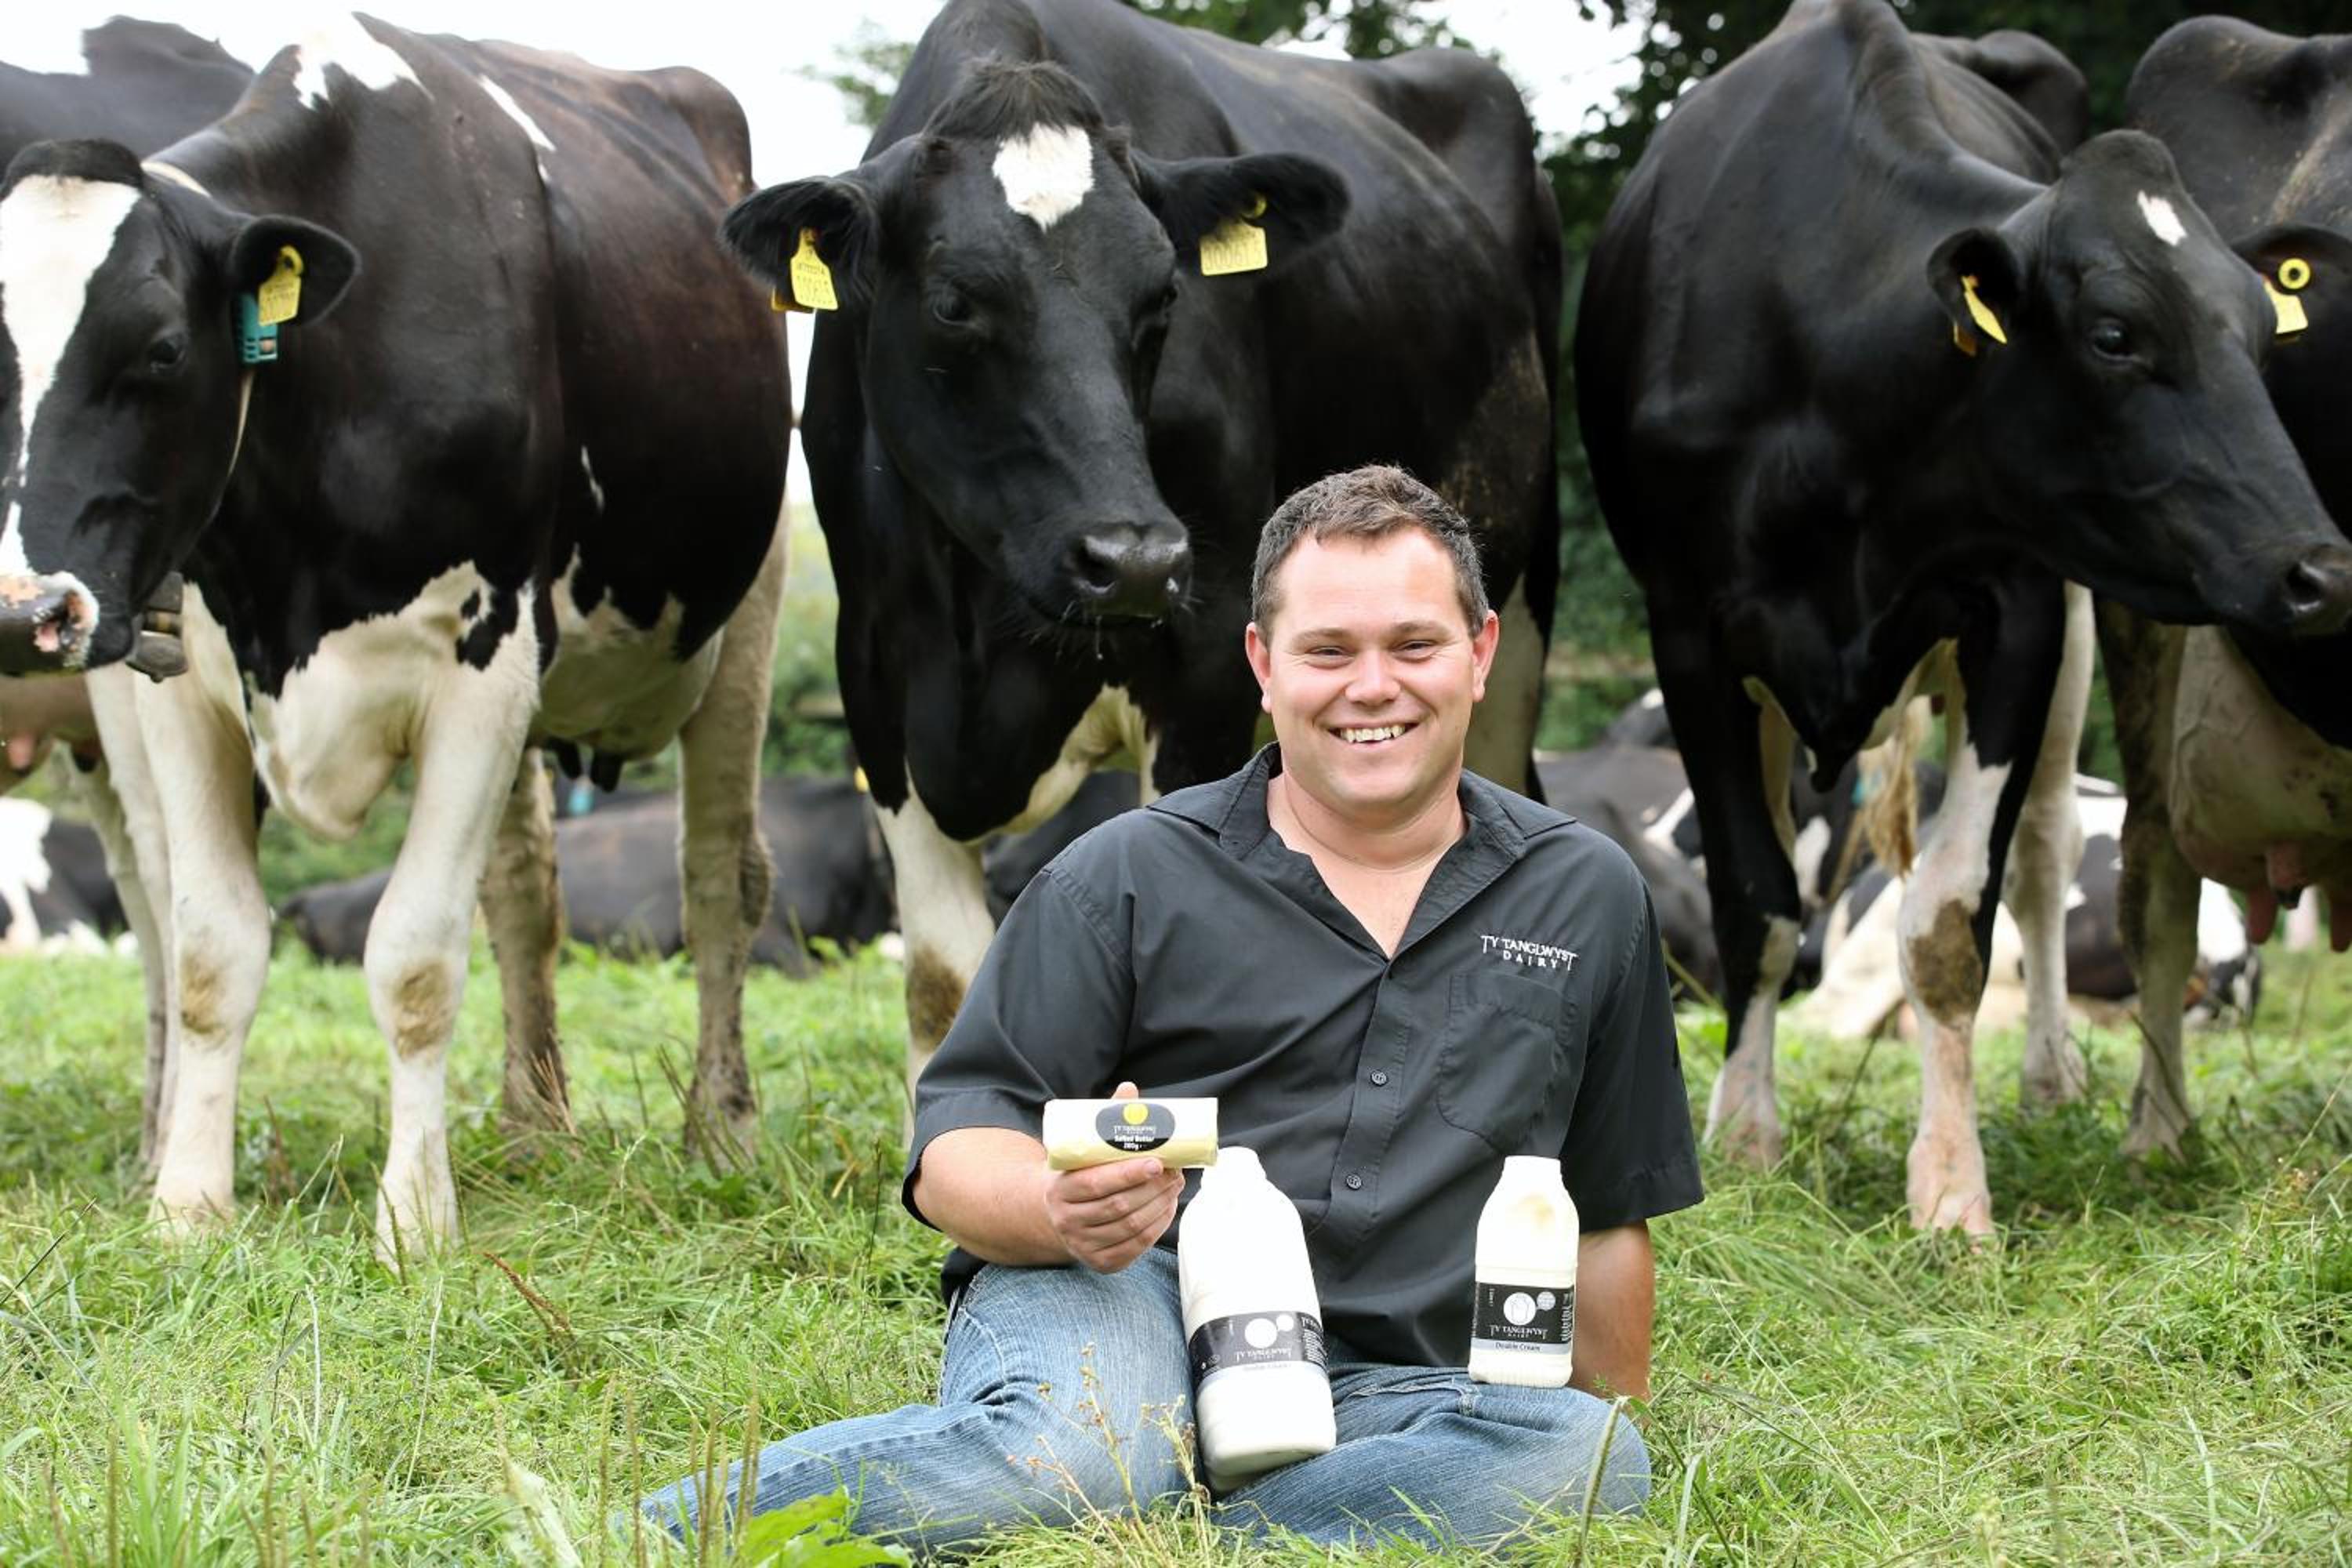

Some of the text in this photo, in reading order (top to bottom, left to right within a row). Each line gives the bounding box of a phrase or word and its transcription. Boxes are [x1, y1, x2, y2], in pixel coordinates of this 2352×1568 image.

[1480, 935, 1579, 971] TY TANGLWYST
[1503, 949, 1558, 969] DAIRY
[1490, 1325, 1501, 1337] TY
